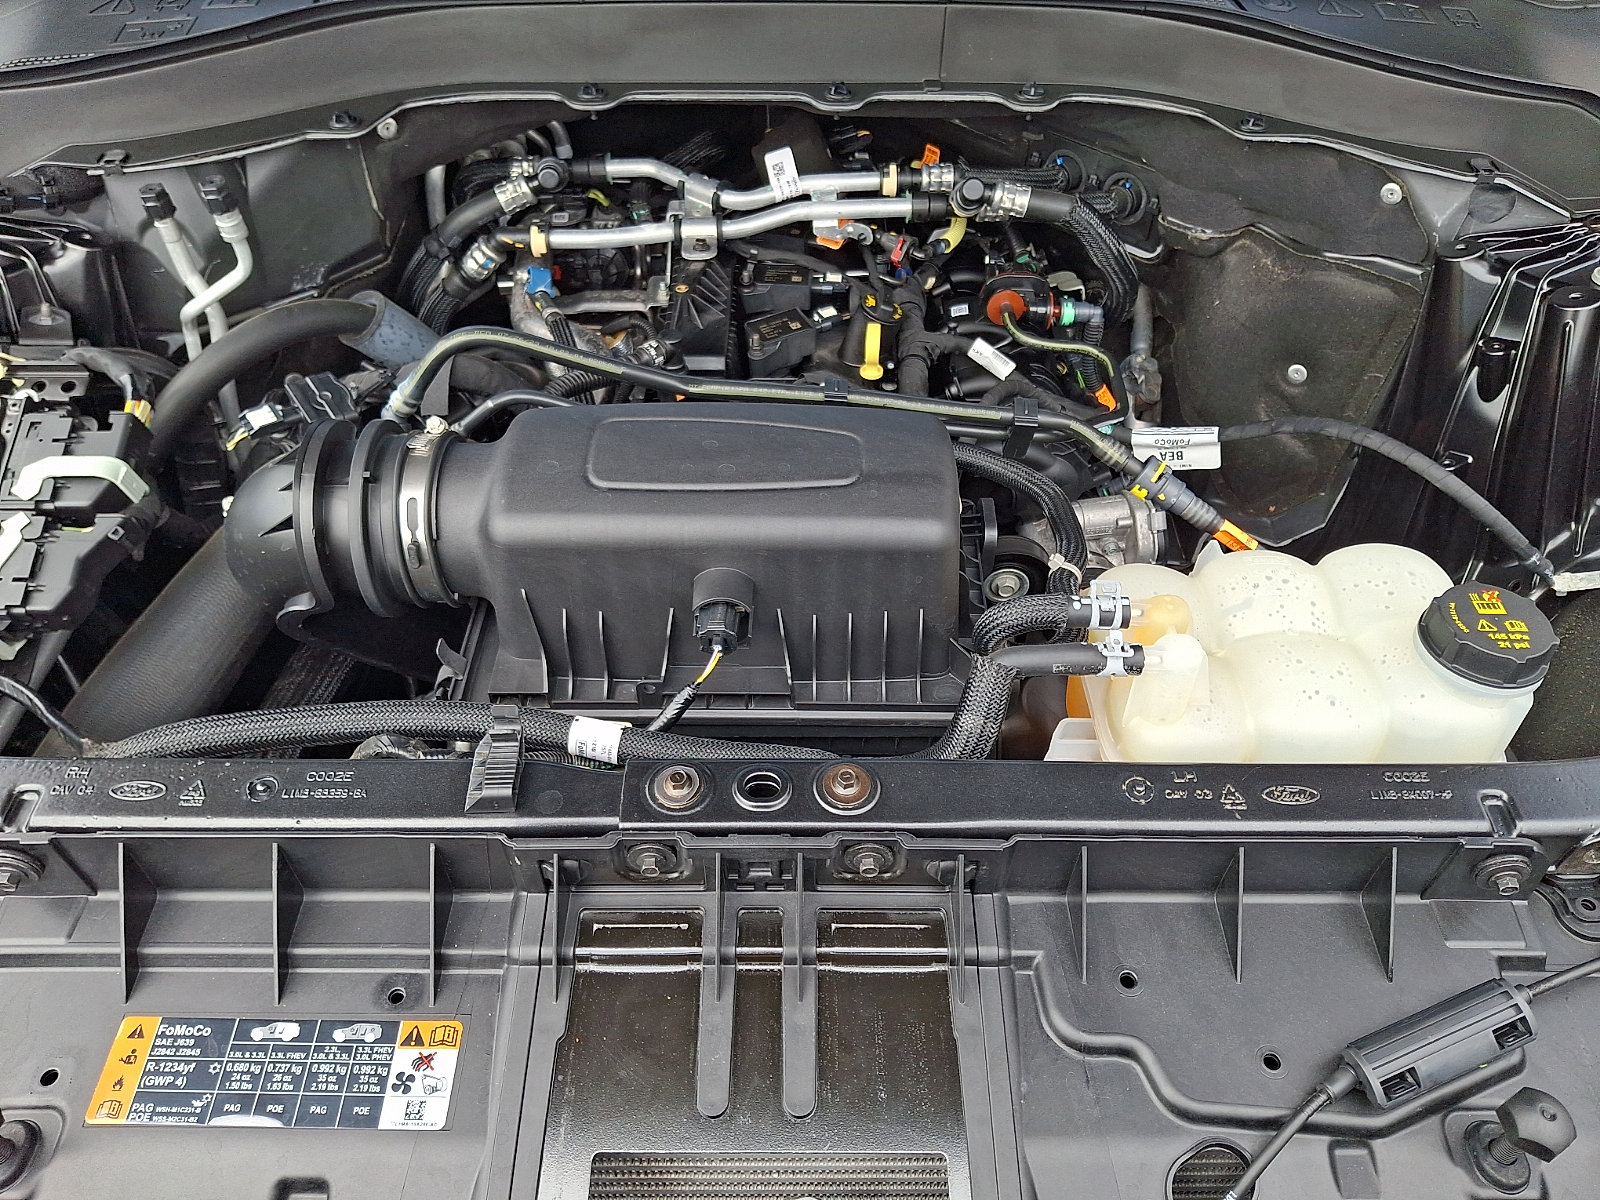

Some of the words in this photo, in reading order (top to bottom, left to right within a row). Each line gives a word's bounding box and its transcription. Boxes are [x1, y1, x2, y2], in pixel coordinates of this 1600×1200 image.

[1155, 438, 1191, 446] FoMoCo
[1160, 450, 1184, 461] BEA
[65, 766, 92, 778] RH
[158, 1024, 212, 1037] FoMoCo
[154, 1038, 173, 1046] SAE
[174, 1038, 195, 1046] J639
[146, 1062, 197, 1075] R-1234yf
[226, 1062, 249, 1072] 0.680
[250, 1063, 262, 1074] kg
[267, 1063, 290, 1073] 0.737
[291, 1064, 303, 1075] kg
[312, 1064, 335, 1073] 0.992
[336, 1065, 347, 1075] kg
[353, 1065, 376, 1074] 0.992
[377, 1066, 389, 1077] kg
[140, 1075, 174, 1088] (GWP
[174, 1076, 187, 1088] 4)
[359, 1075, 368, 1083] 35
[225, 1082, 240, 1090] 1.50
[240, 1082, 253, 1090] lbs
[310, 1083, 326, 1091] 2.19
[327, 1083, 339, 1091] lbs
[352, 1084, 368, 1092] 2.19
[369, 1084, 381, 1092] lbs
[132, 1103, 154, 1113] PAG
[223, 1104, 241, 1112] PAG
[266, 1105, 284, 1113] POE
[309, 1106, 328, 1114] PAG
[353, 1107, 370, 1115] POE
[128, 1113, 151, 1122] POE
